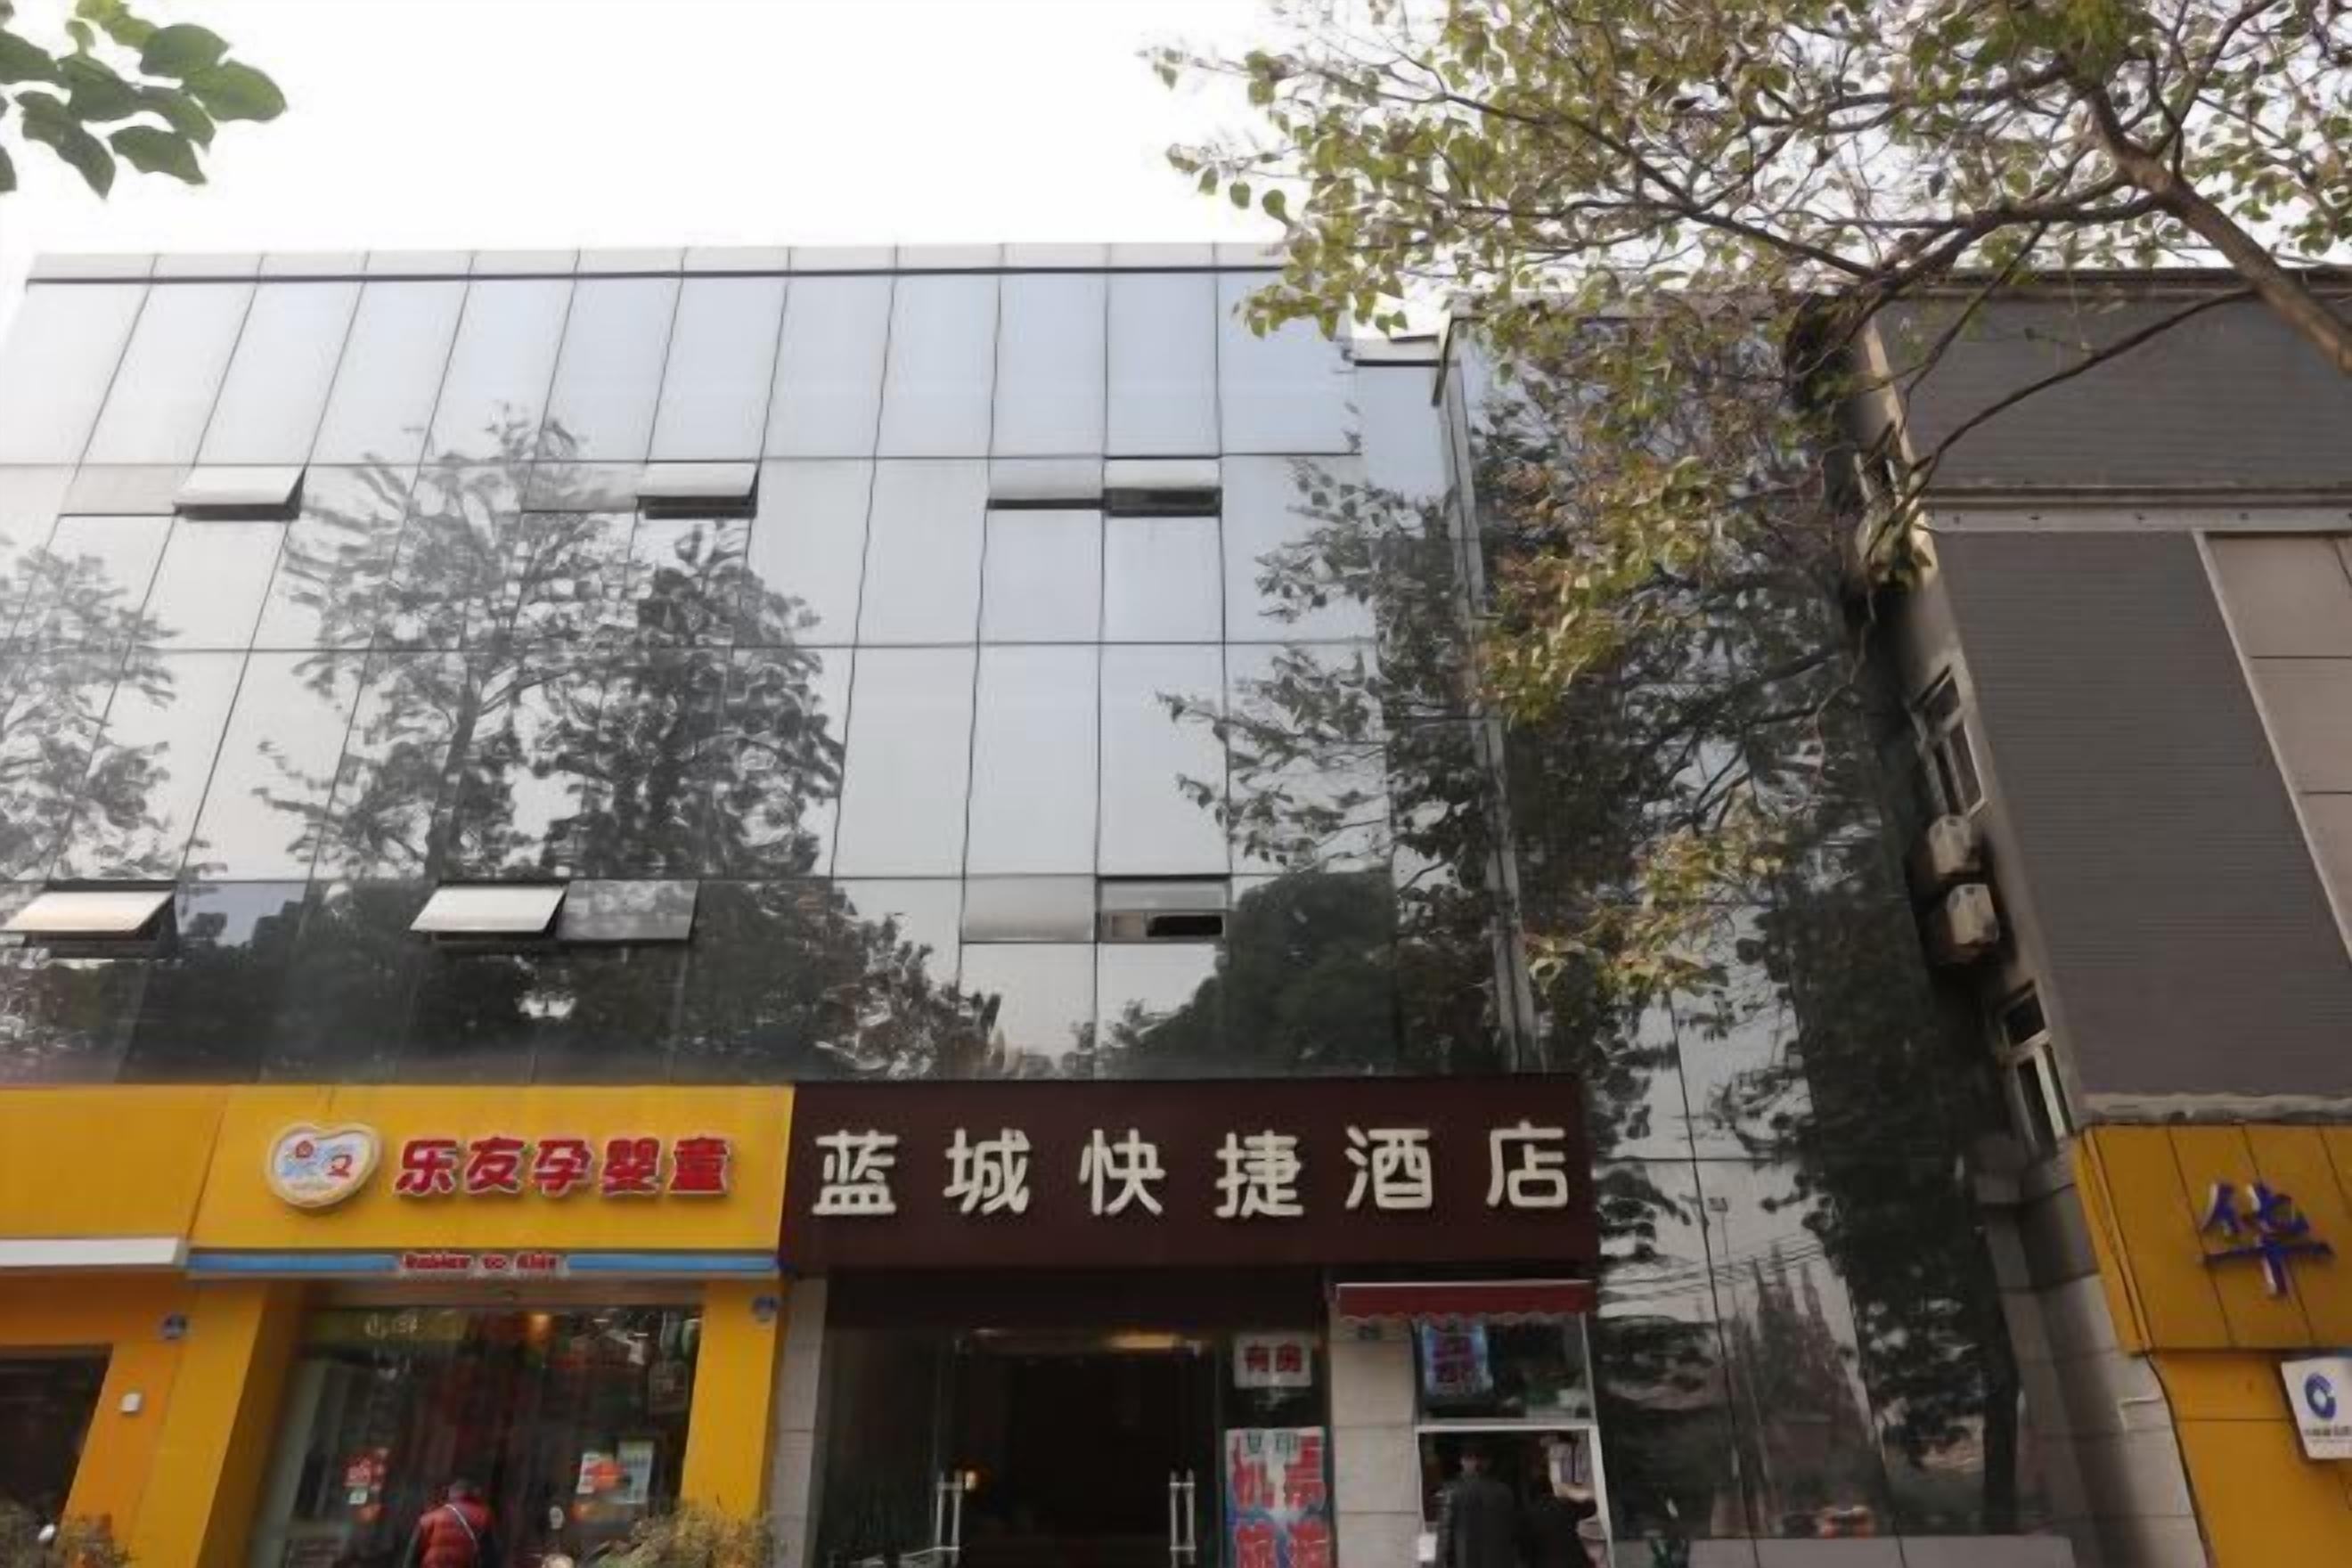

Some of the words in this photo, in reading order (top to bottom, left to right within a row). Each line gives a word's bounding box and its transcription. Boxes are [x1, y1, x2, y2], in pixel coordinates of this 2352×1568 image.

[395, 1136, 729, 1195] 乐友孕婴童
[812, 1121, 1569, 1218] 蓝城快捷酒店
[2200, 1179, 2334, 1296] 华
